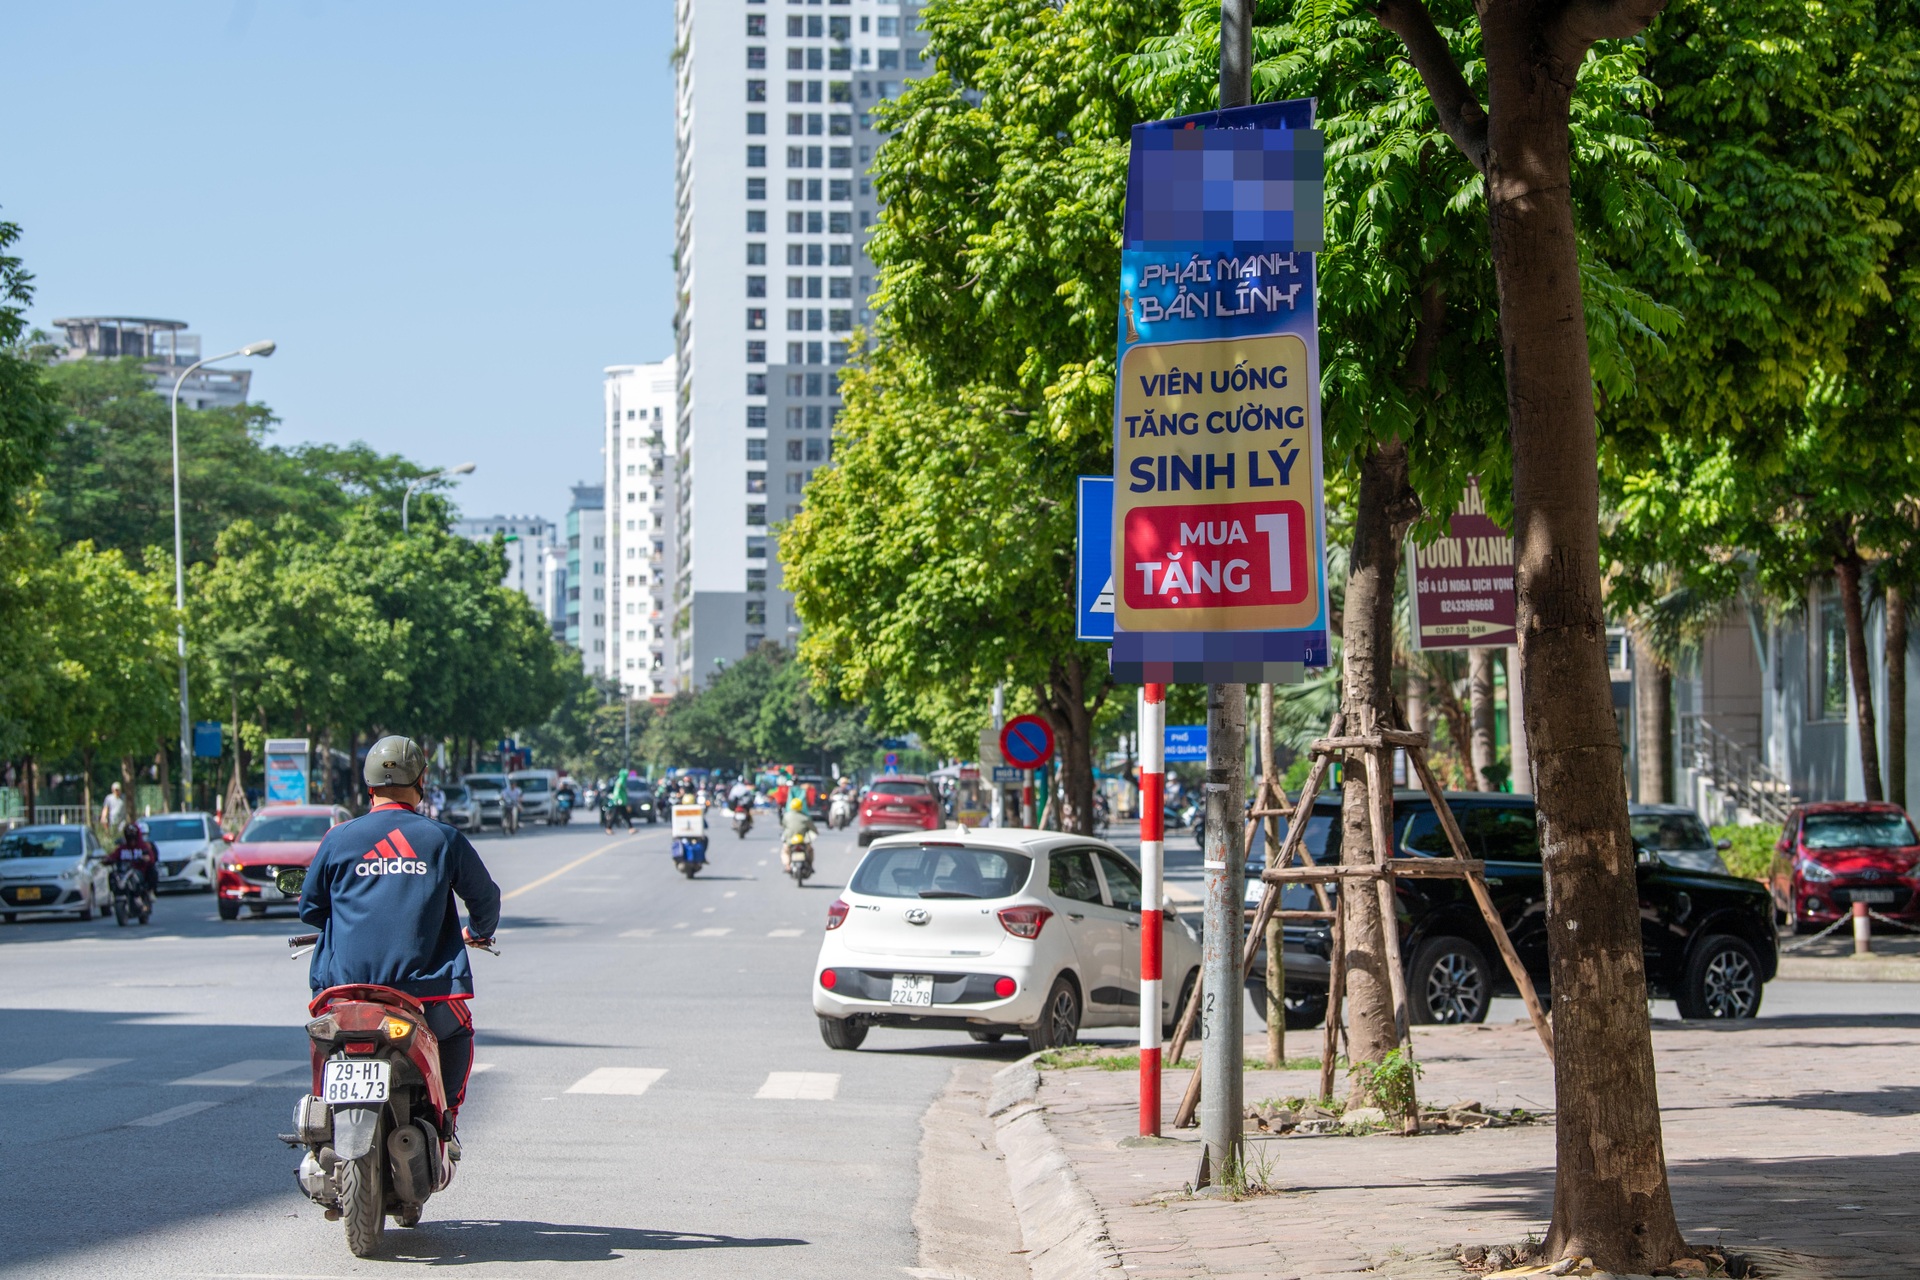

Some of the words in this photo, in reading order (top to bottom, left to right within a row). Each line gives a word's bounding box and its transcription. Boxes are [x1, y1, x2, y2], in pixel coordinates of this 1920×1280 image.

[1138, 254, 1212, 288] PHÁI
[1138, 284, 1209, 323] BẢN
[1139, 367, 1203, 397] VIÊN
[1210, 359, 1288, 394] UỐNG
[1125, 409, 1199, 438] TĂNG
[1206, 402, 1304, 434] CƯỜNG
[1129, 452, 1235, 493] SINH
[1248, 438, 1300, 488] LÝ
[1180, 520, 1249, 546] MUA
[1255, 513, 1292, 592] 1
[1465, 536, 1513, 567] XANH
[1135, 551, 1251, 604] TẶNG
[355, 857, 427, 876] adidas
[335, 1063, 380, 1080] 29-H1
[329, 1081, 385, 1100] 884.73
